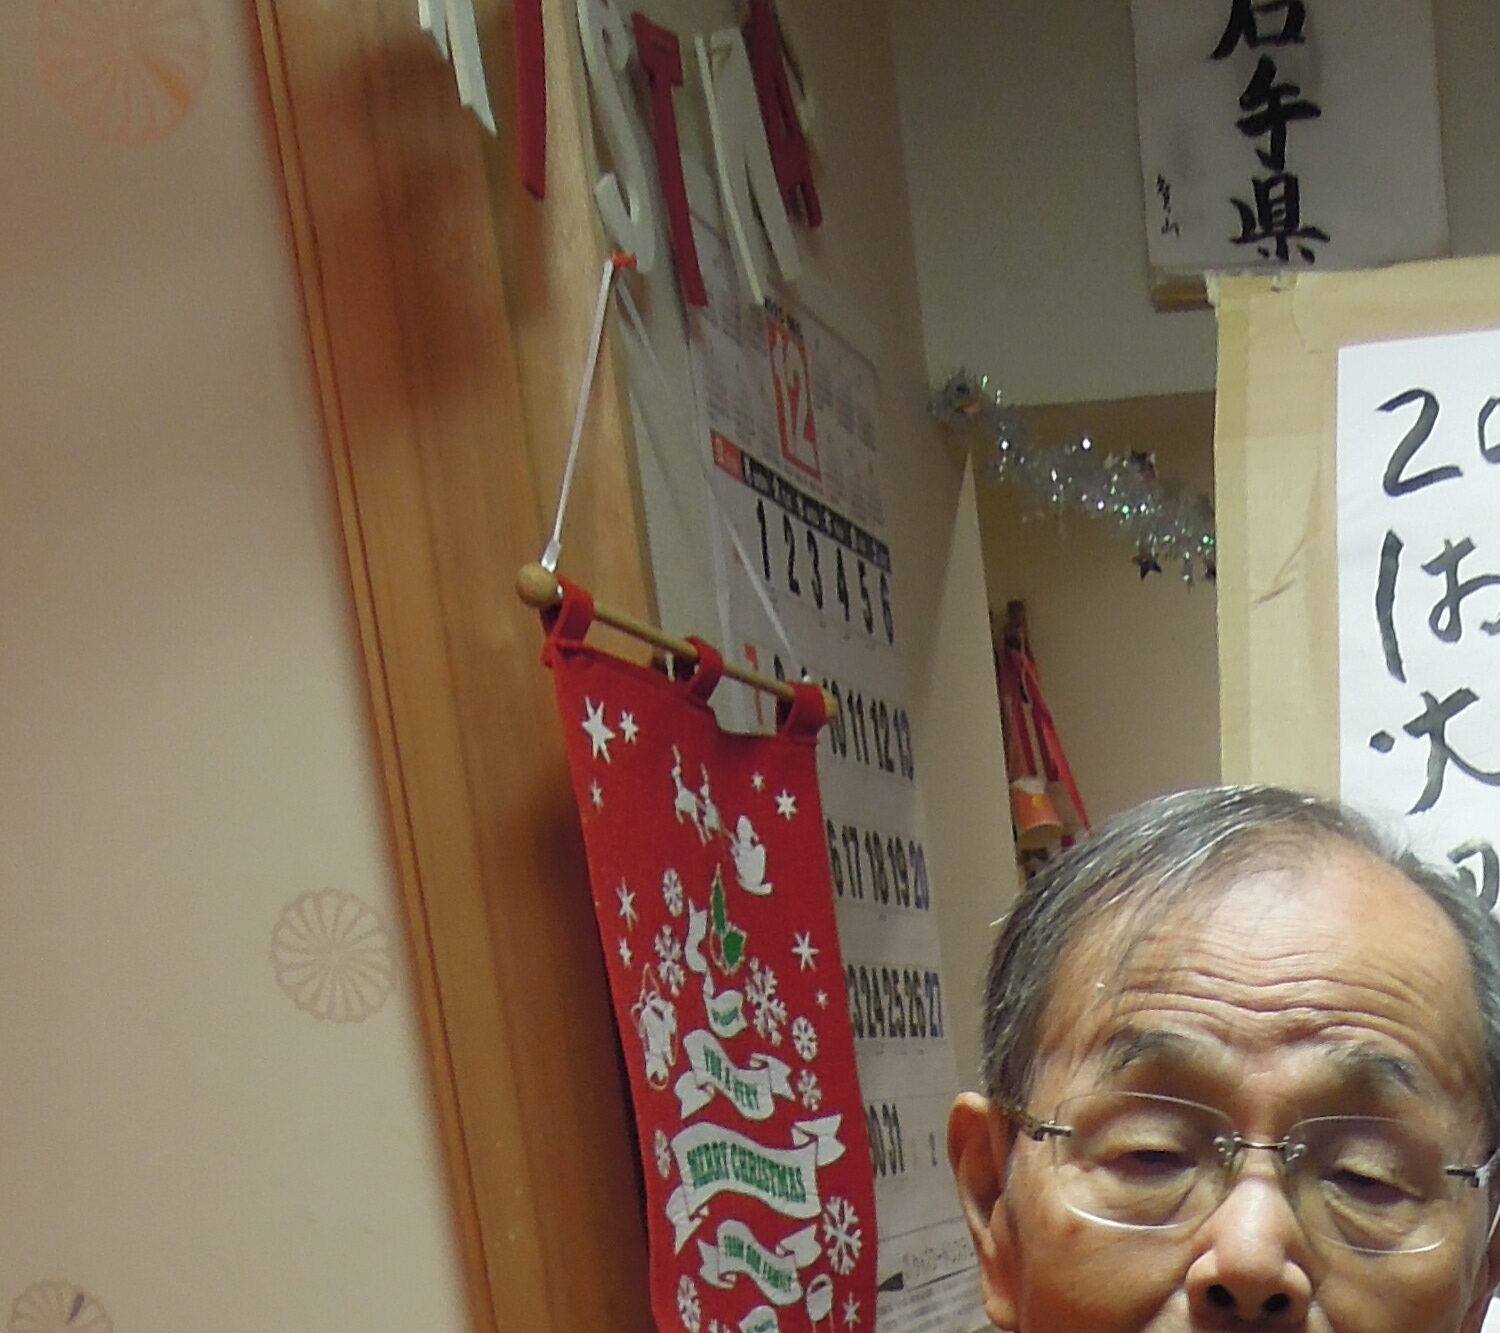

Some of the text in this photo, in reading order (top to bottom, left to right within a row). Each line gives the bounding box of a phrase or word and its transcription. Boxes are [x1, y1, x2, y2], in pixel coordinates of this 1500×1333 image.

[757, 498, 771, 582] 1
[782, 513, 801, 596] 2
[806, 529, 825, 610] 3
[837, 546, 852, 623] 4
[857, 559, 874, 635] 5
[826, 818, 844, 898] 6
[846, 963, 865, 1039] 3
